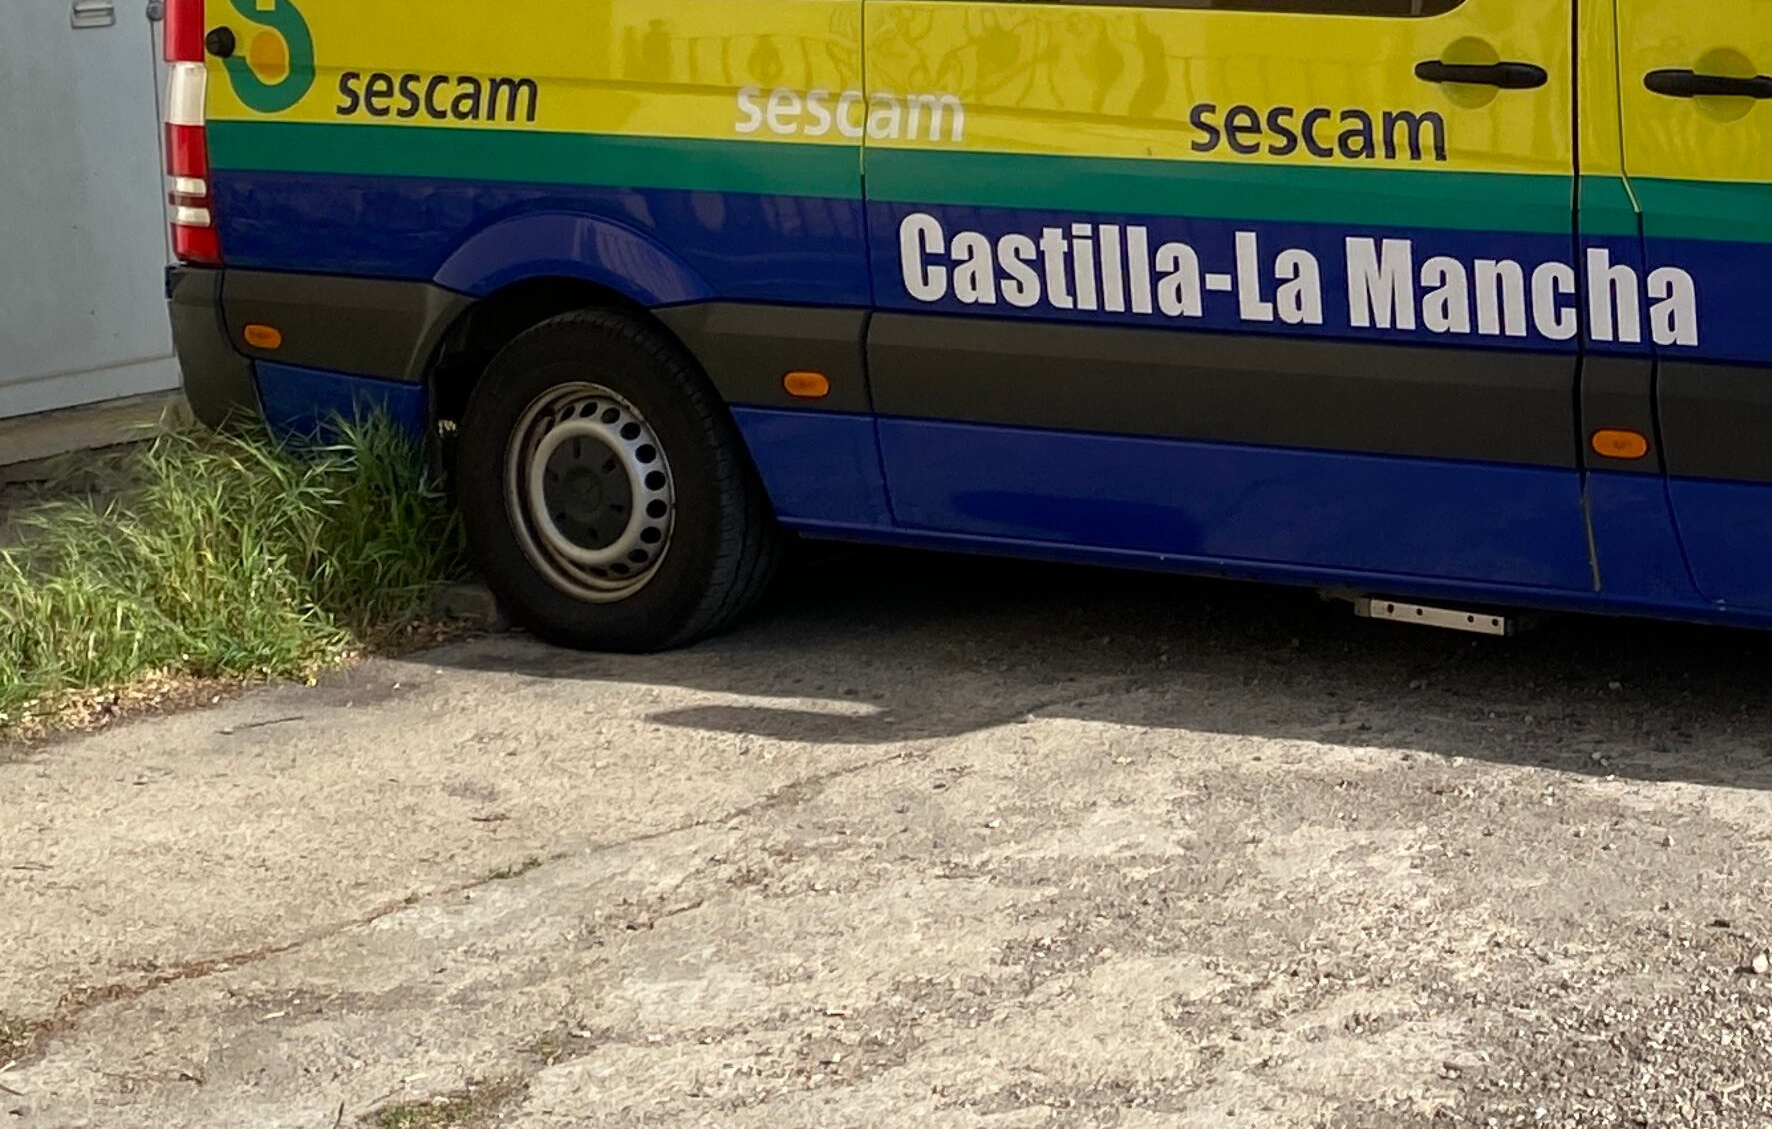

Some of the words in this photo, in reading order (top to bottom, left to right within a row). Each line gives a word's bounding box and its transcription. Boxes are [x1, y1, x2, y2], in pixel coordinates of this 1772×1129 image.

[336, 70, 540, 123] sescam
[734, 84, 966, 143] sescam
[1189, 100, 1448, 162] sescam
[898, 211, 1324, 326] Castilla-La
[1345, 235, 1700, 348] Mancha
